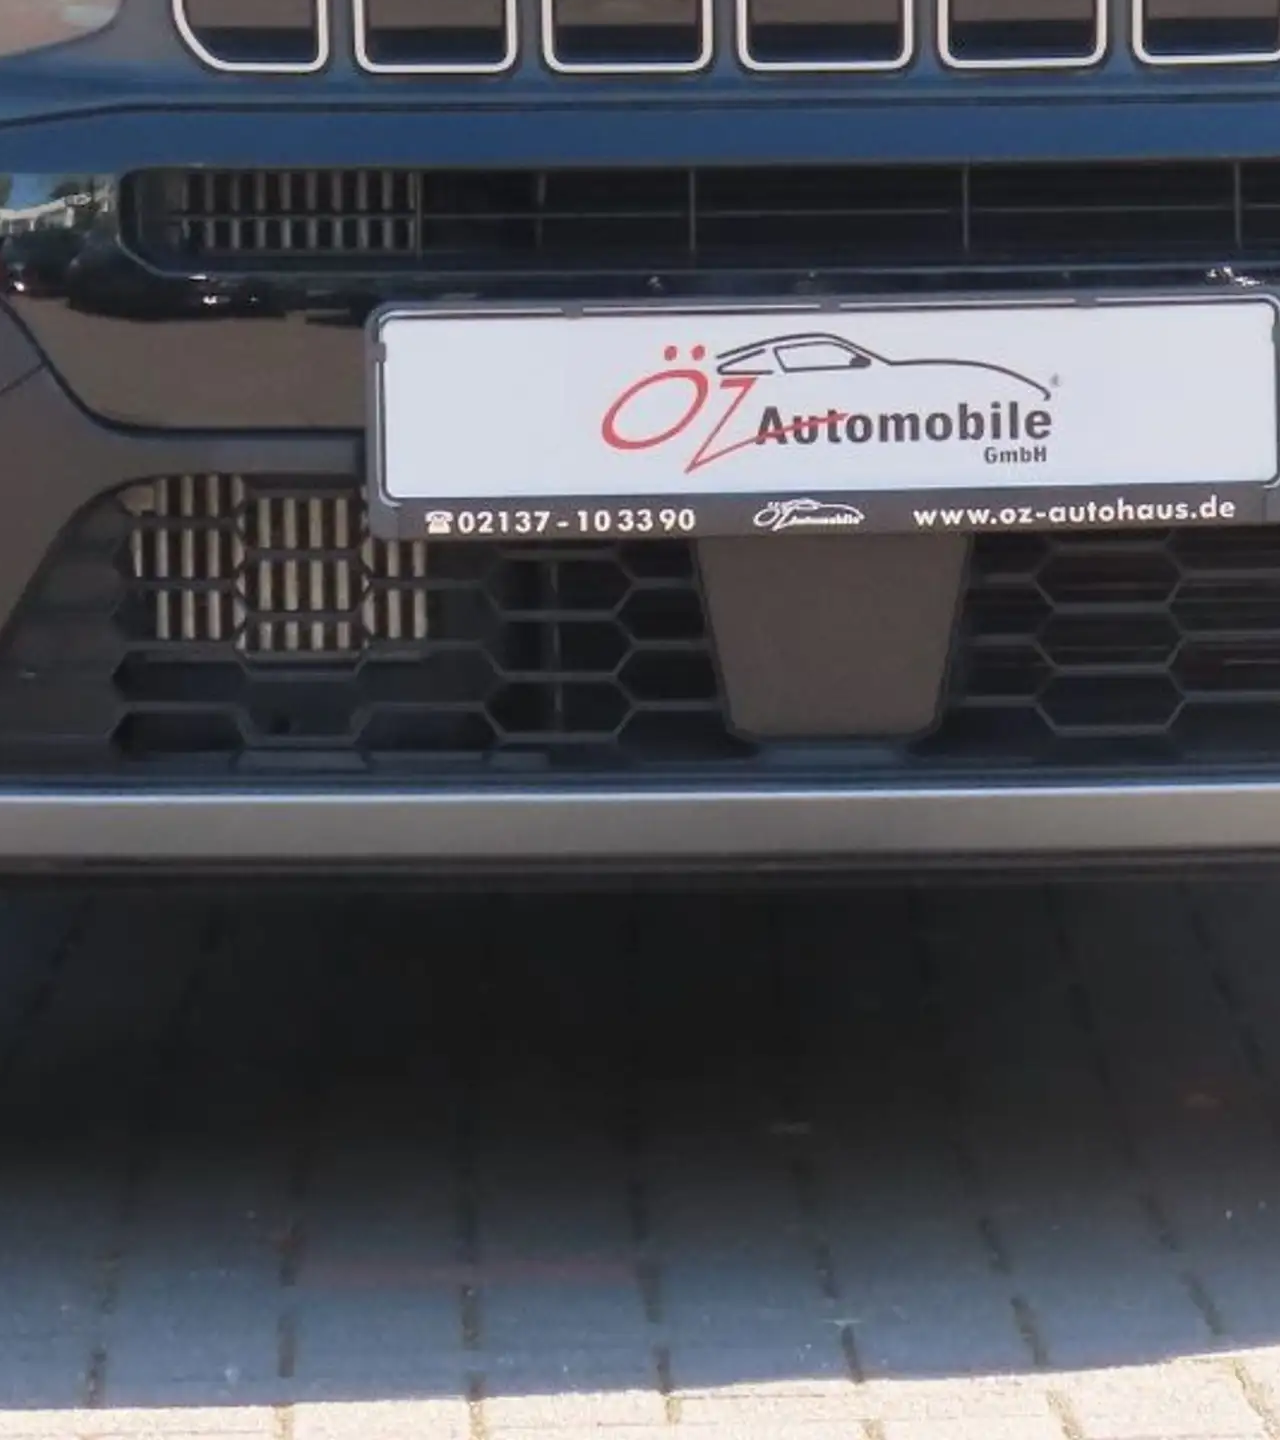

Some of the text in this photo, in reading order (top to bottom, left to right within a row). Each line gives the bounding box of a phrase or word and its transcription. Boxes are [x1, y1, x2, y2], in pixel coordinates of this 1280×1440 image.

[601, 344, 1053, 474] ÖZ Automobile
[983, 444, 1048, 464] GmbH
[913, 495, 1236, 526] www.oz-autohaus.de
